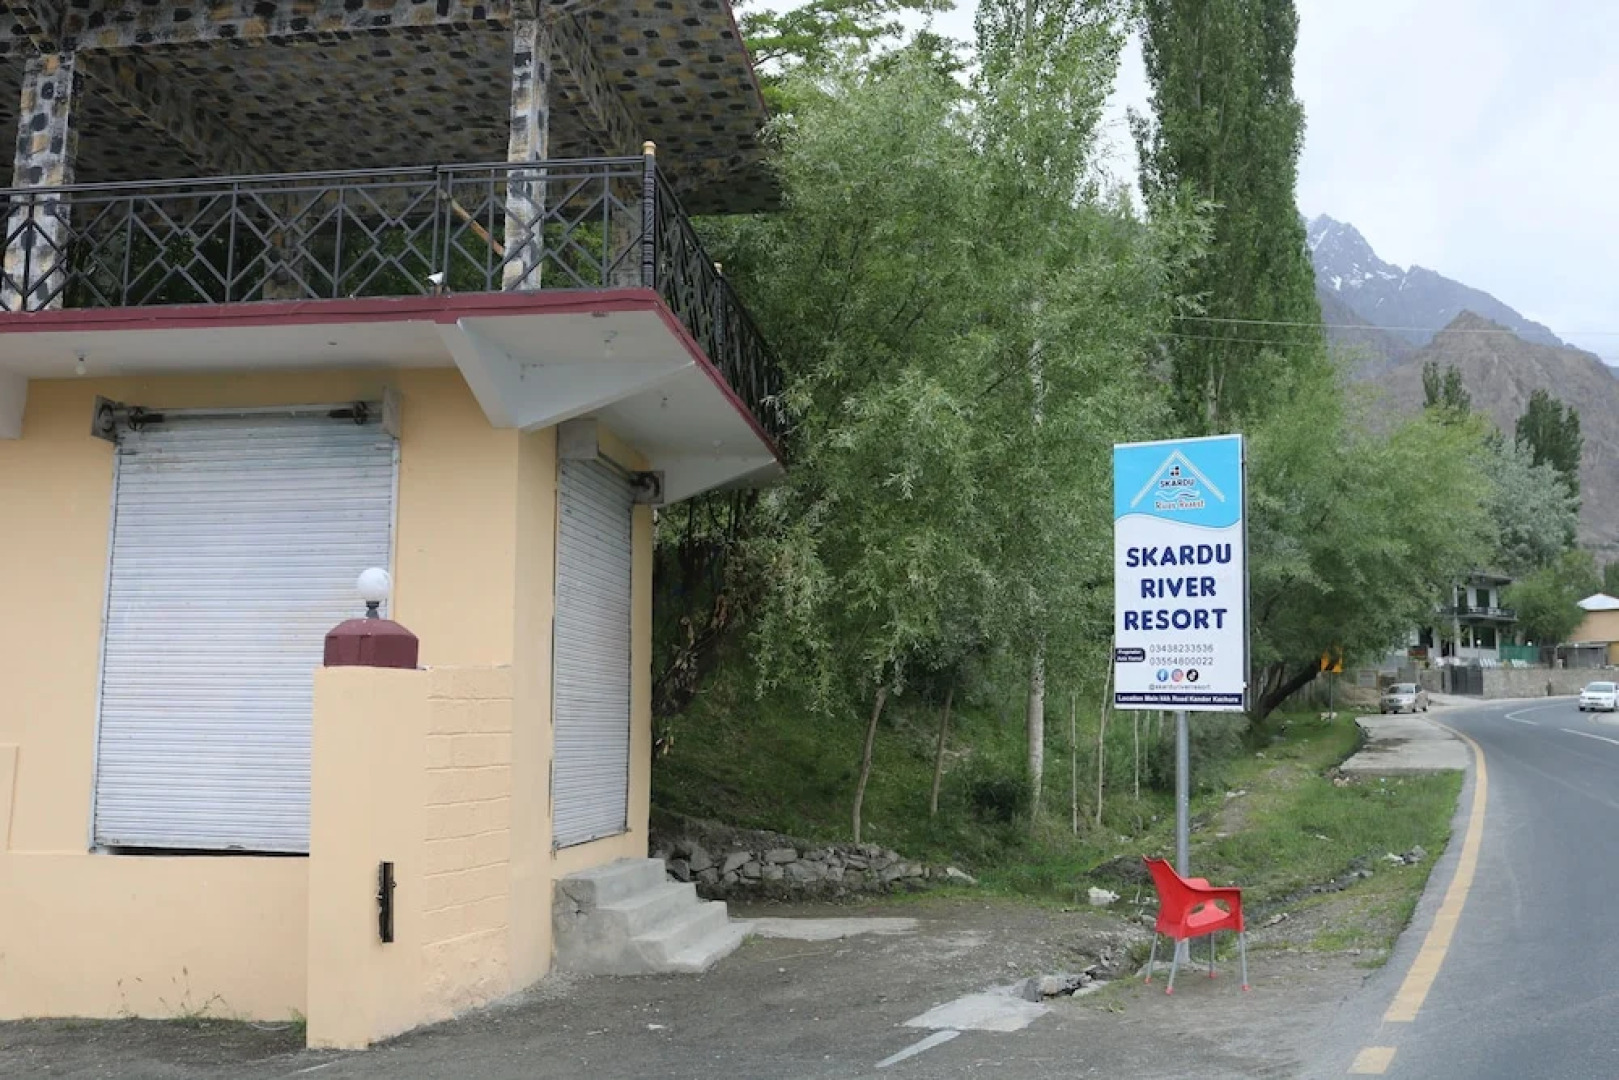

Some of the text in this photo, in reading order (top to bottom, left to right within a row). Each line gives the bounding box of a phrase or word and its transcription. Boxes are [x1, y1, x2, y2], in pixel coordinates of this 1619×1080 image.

[1160, 479, 1194, 487] SKARDU
[1126, 544, 1231, 567] SKARDU
[1141, 576, 1216, 598] RIVER
[1124, 608, 1227, 630] RESORT
[1118, 694, 1143, 702] Location
